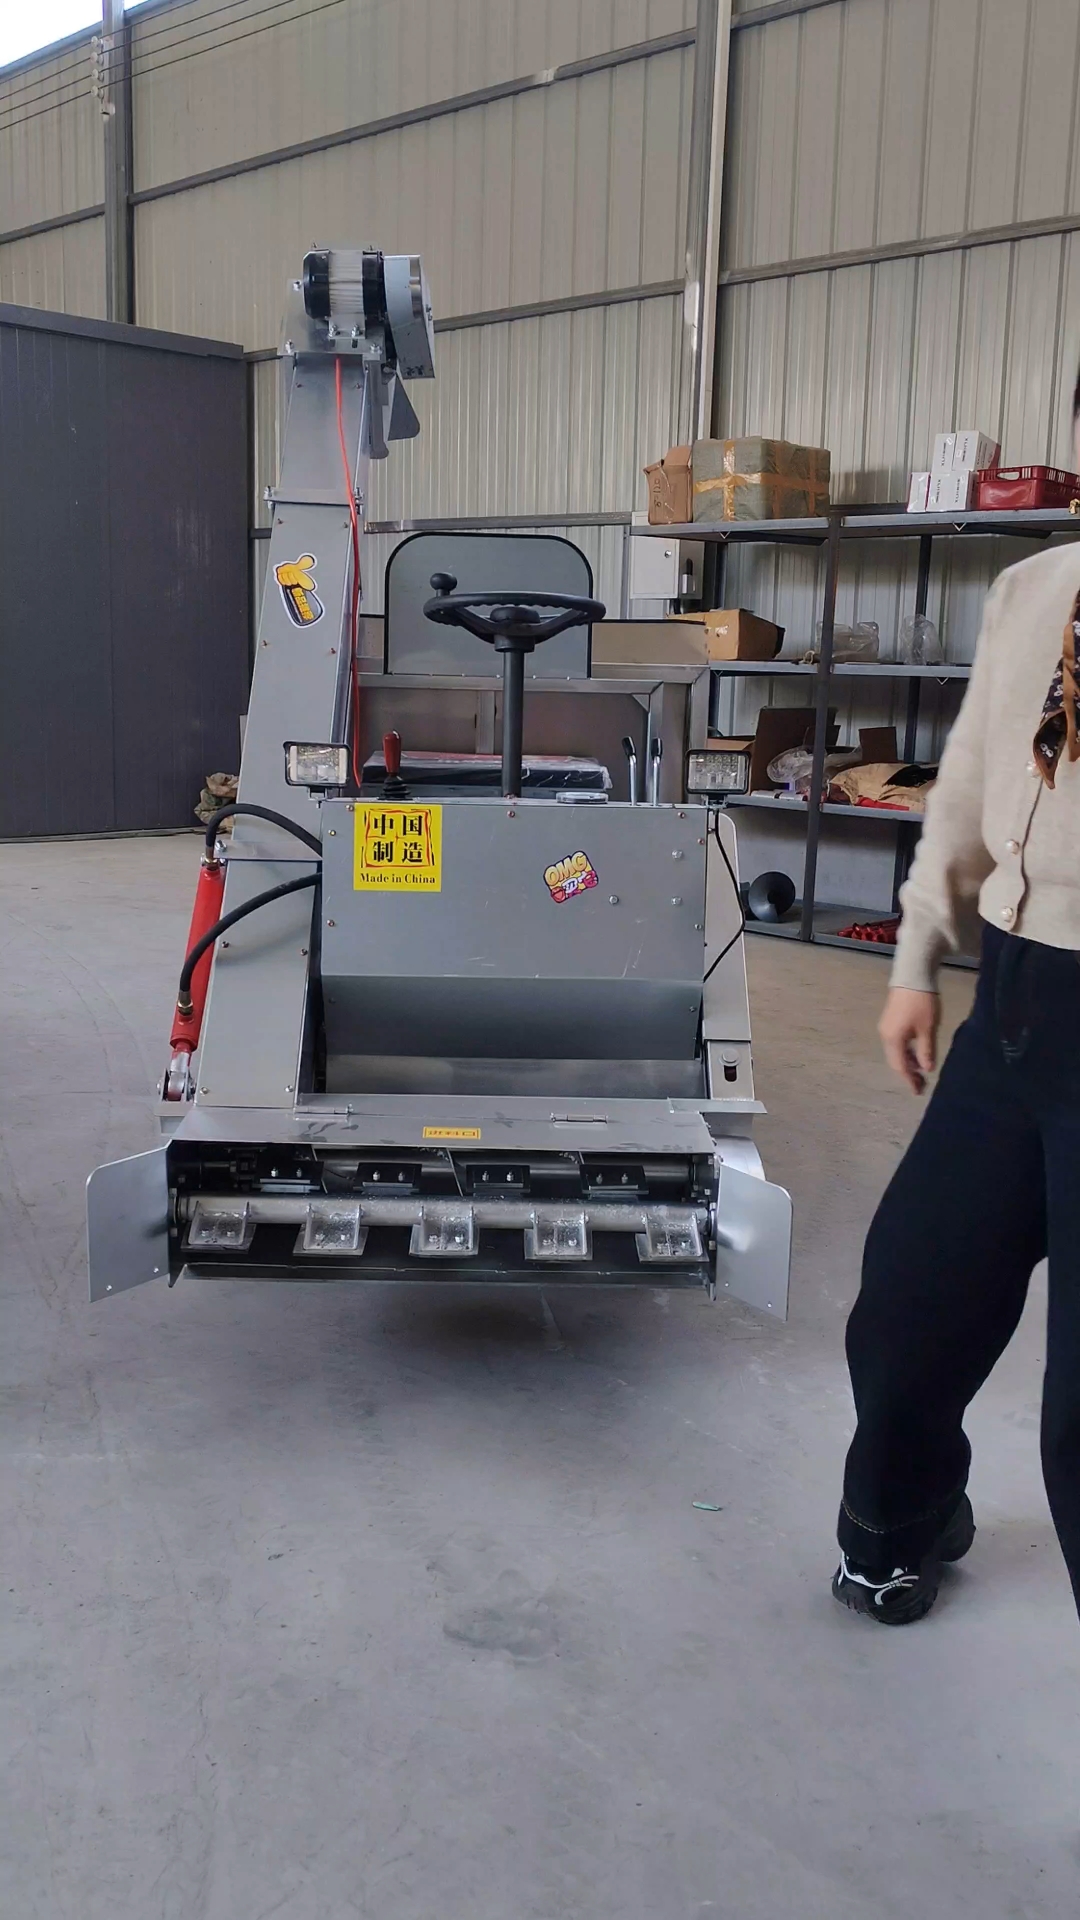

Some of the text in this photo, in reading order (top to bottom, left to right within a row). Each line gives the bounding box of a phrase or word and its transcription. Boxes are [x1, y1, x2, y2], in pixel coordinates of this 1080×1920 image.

[373, 814, 423, 836] 中国
[373, 841, 423, 863] 制造
[360, 873, 436, 884] Made in China
[544, 851, 588, 887] OMG
